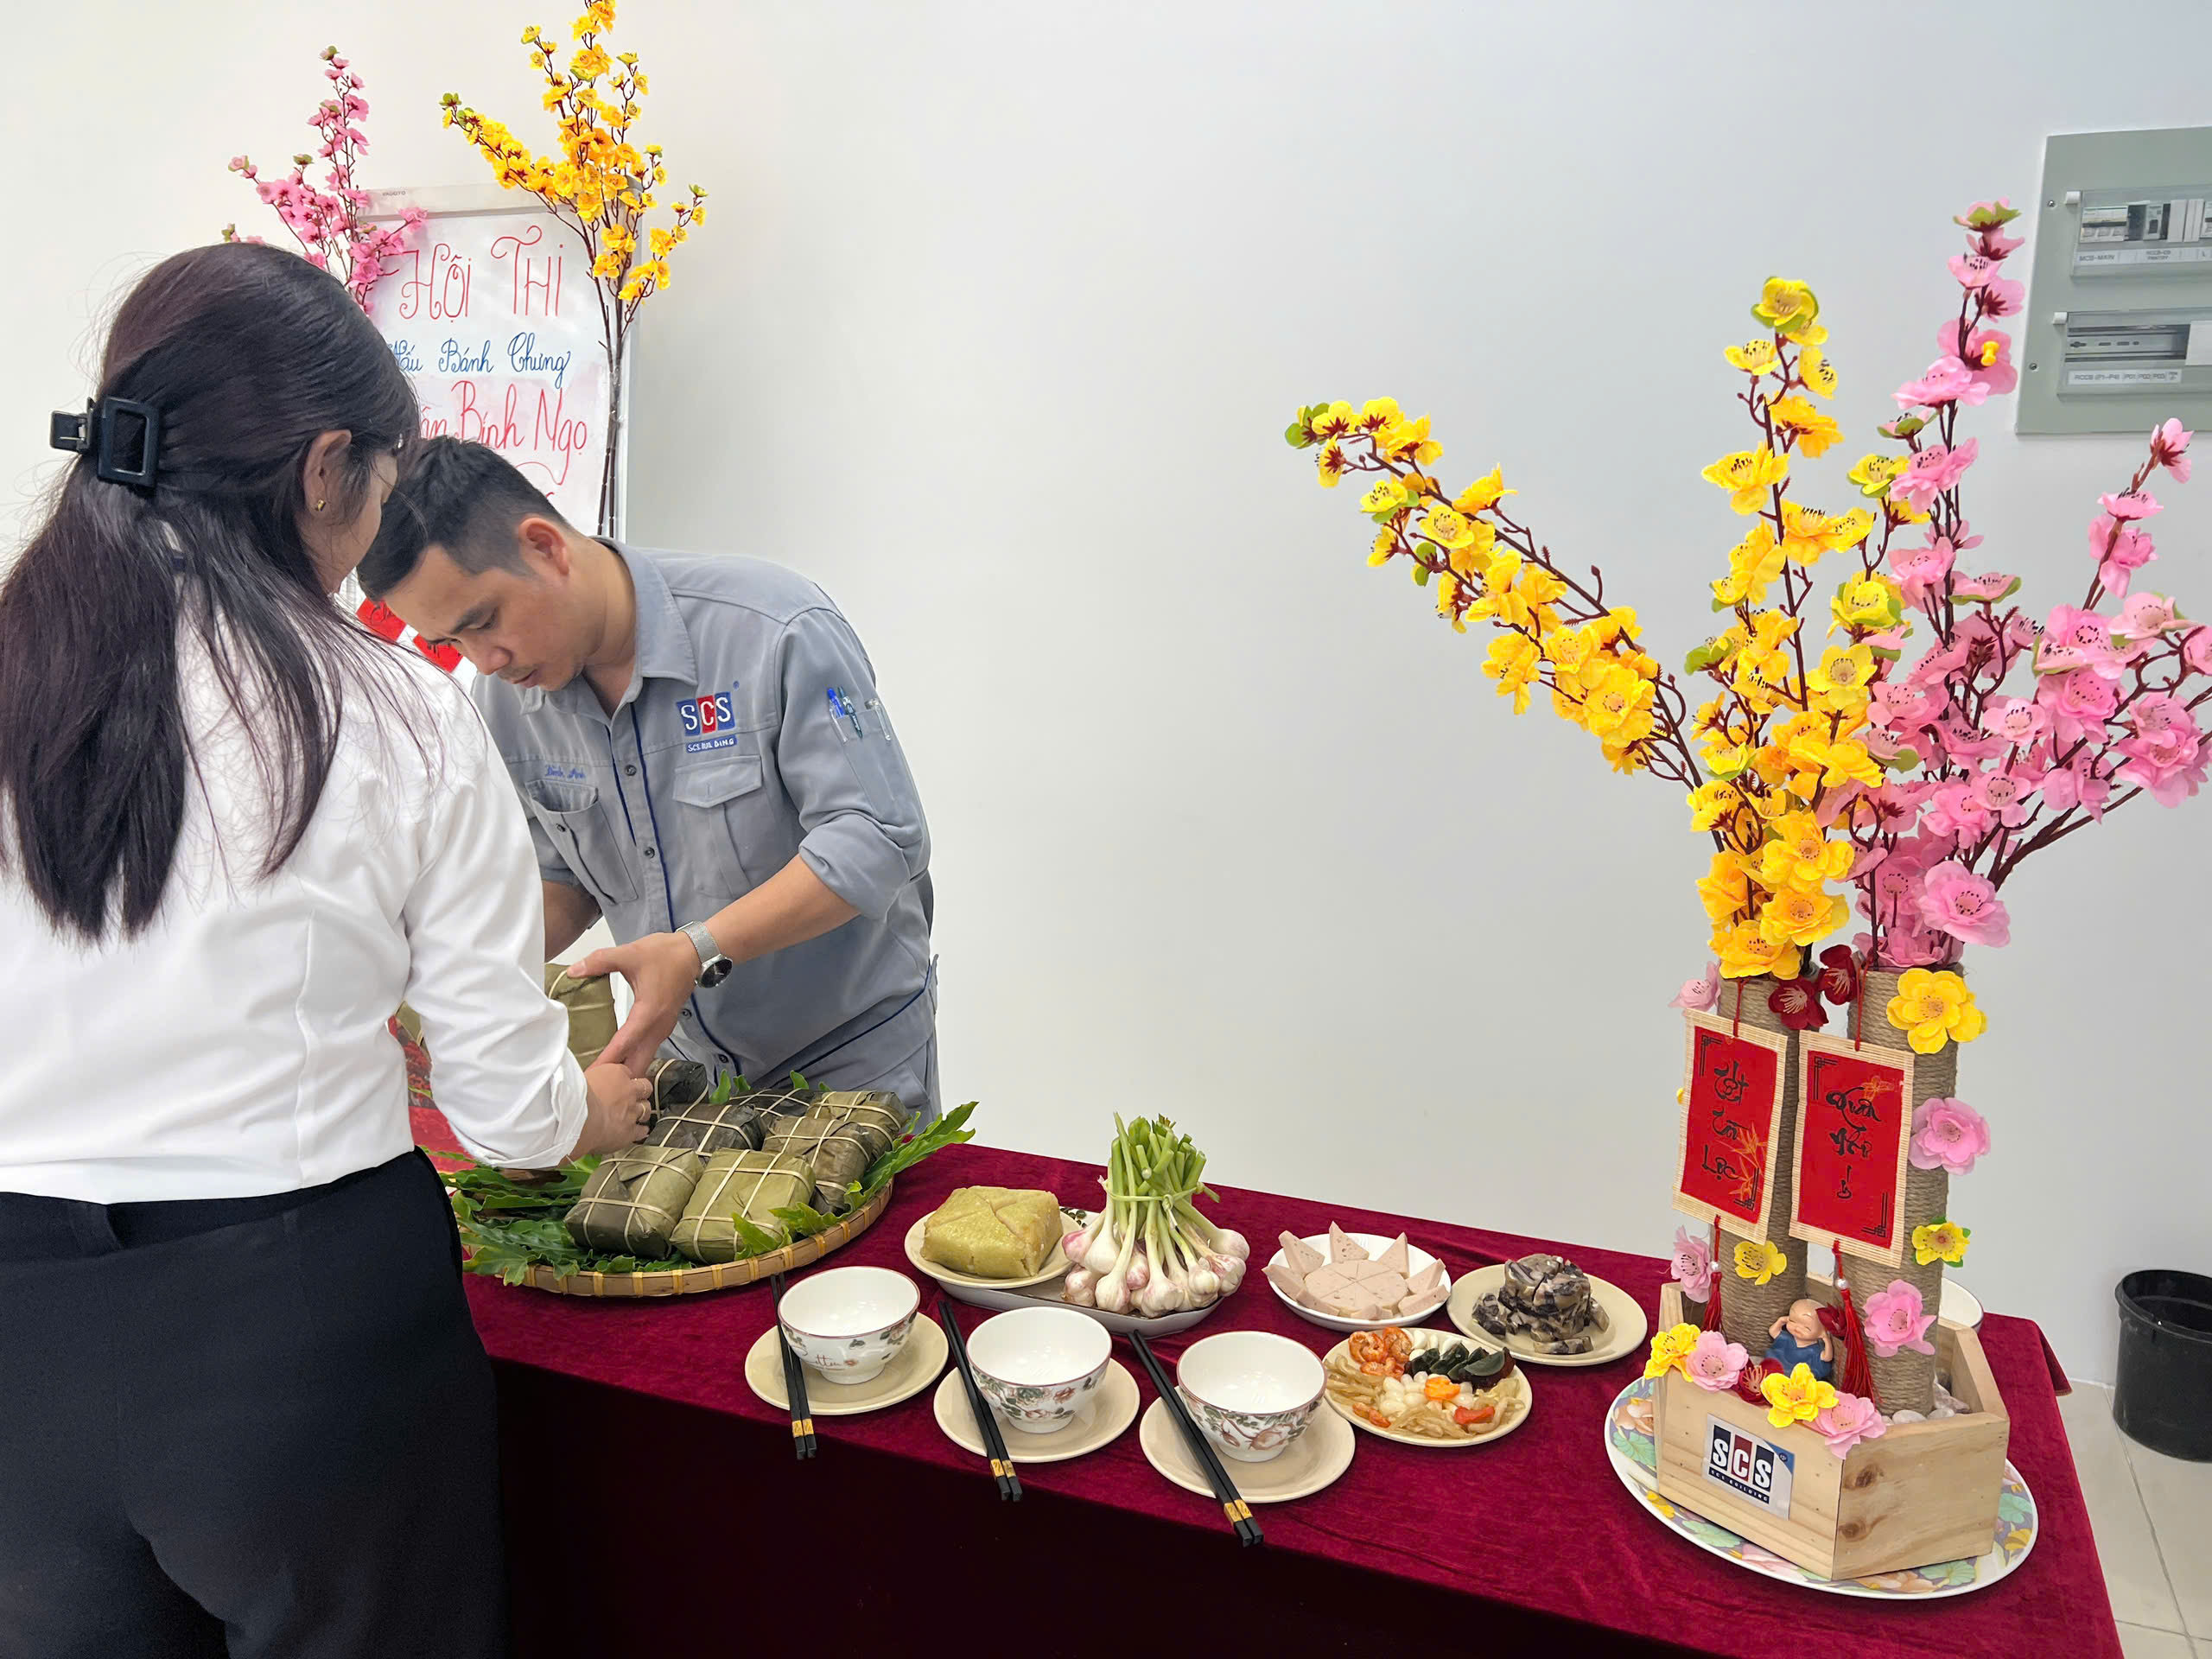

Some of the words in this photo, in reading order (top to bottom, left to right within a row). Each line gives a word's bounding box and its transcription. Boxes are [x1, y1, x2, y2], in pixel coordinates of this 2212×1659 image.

[438, 337, 495, 373] Bánh
[680, 696, 731, 731] SCS
[1712, 1438, 1772, 1489] SCS
